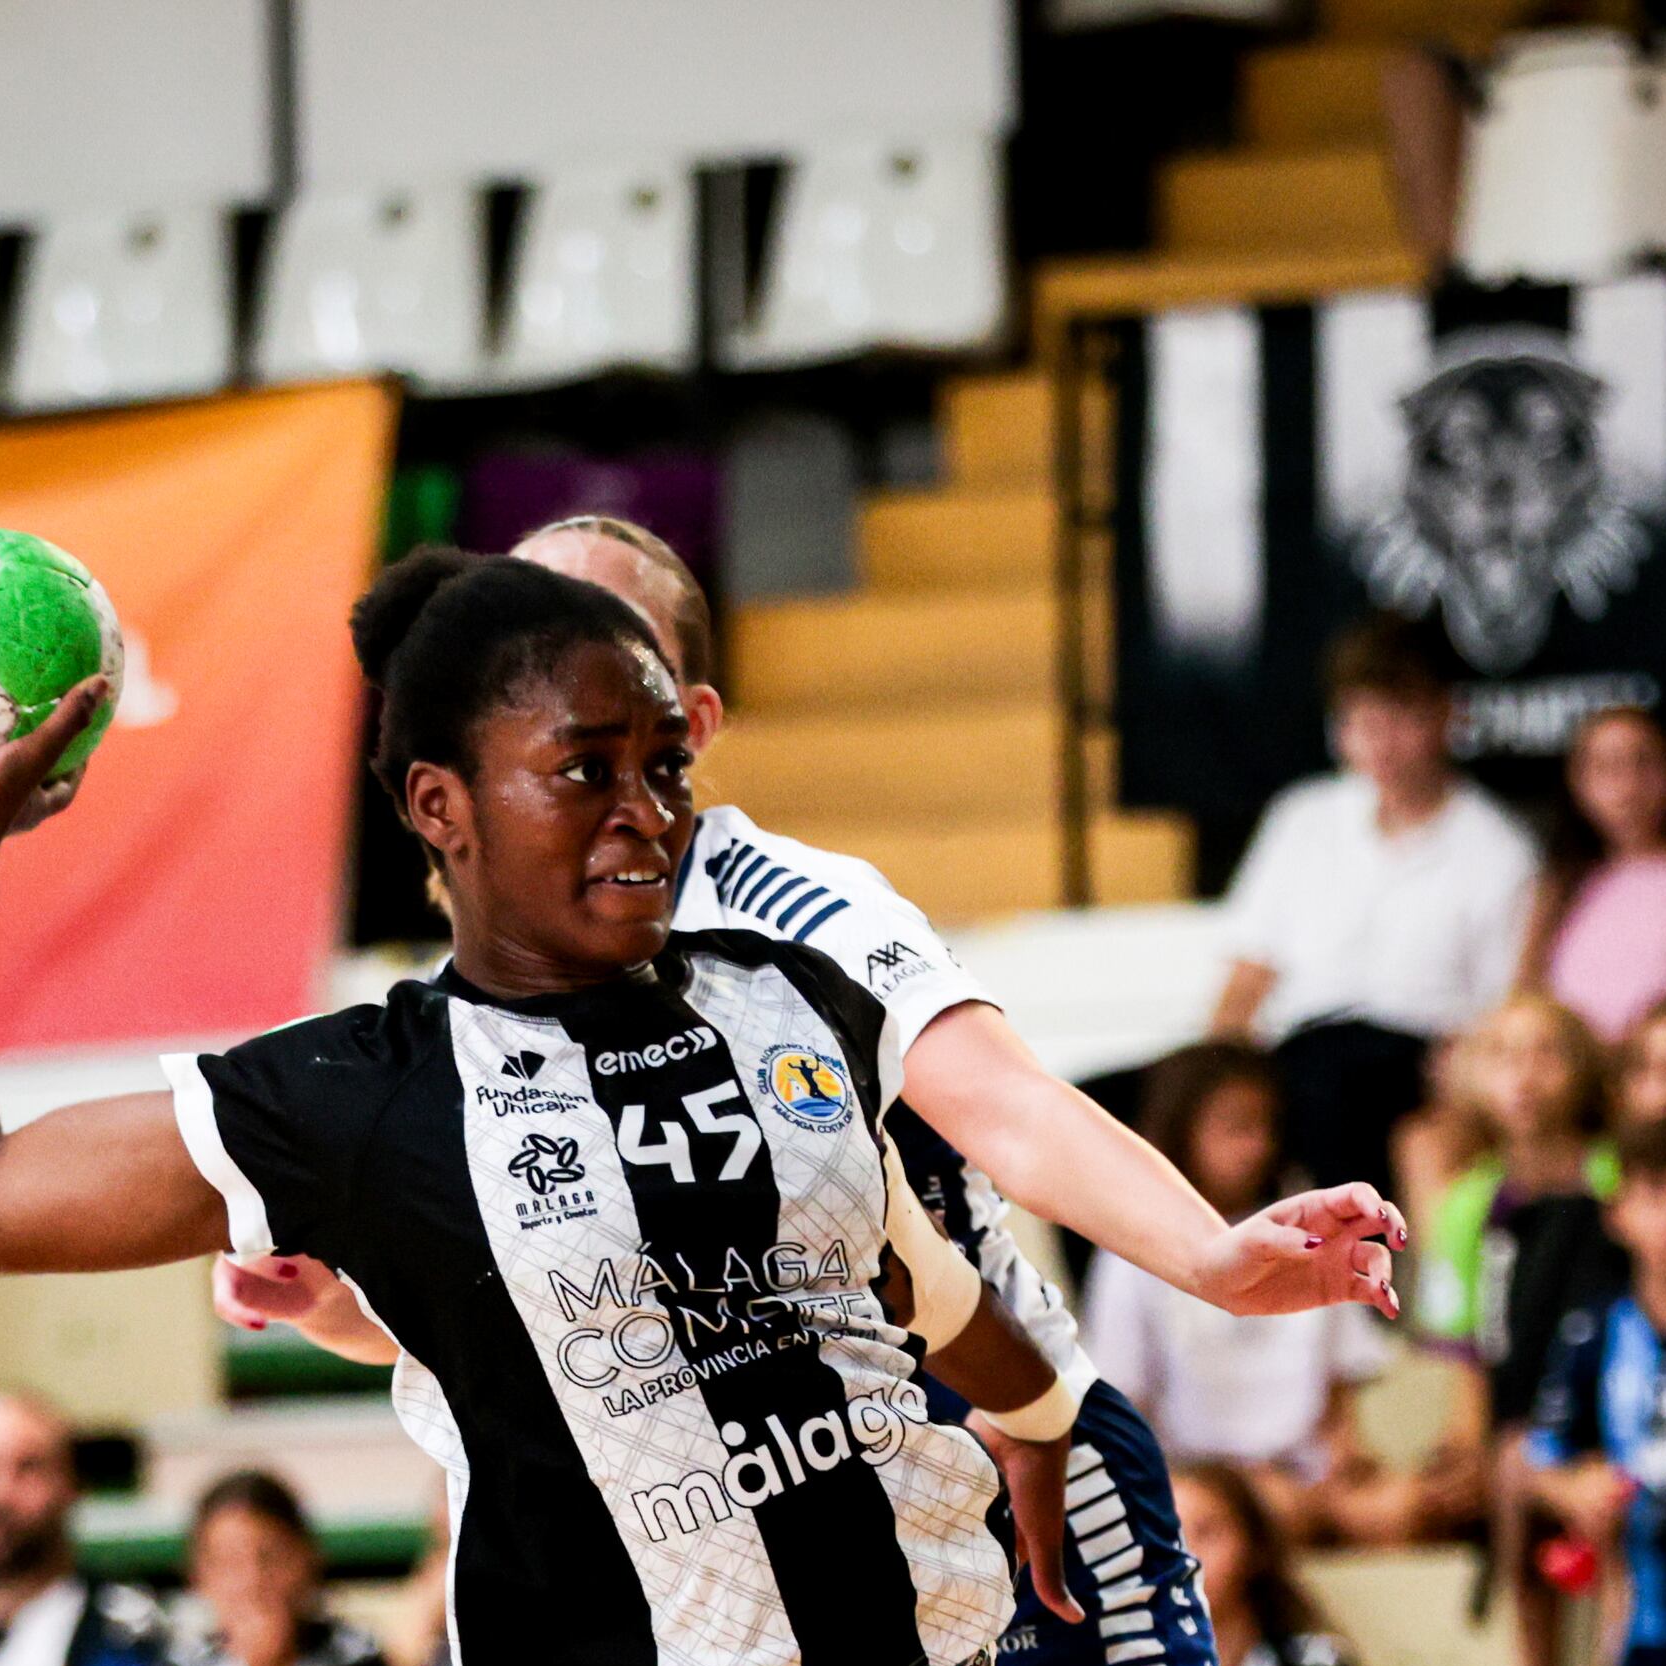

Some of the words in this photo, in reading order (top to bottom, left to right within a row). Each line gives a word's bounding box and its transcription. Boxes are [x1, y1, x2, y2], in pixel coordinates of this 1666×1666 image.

[867, 941, 920, 986] AXA
[493, 1099, 579, 1117] Unicaja
[617, 1079, 762, 1183] 45
[548, 1239, 851, 1322] MÁLAGA
[602, 1388, 643, 1418] LA
[641, 1339, 771, 1403] PROVINCIA
